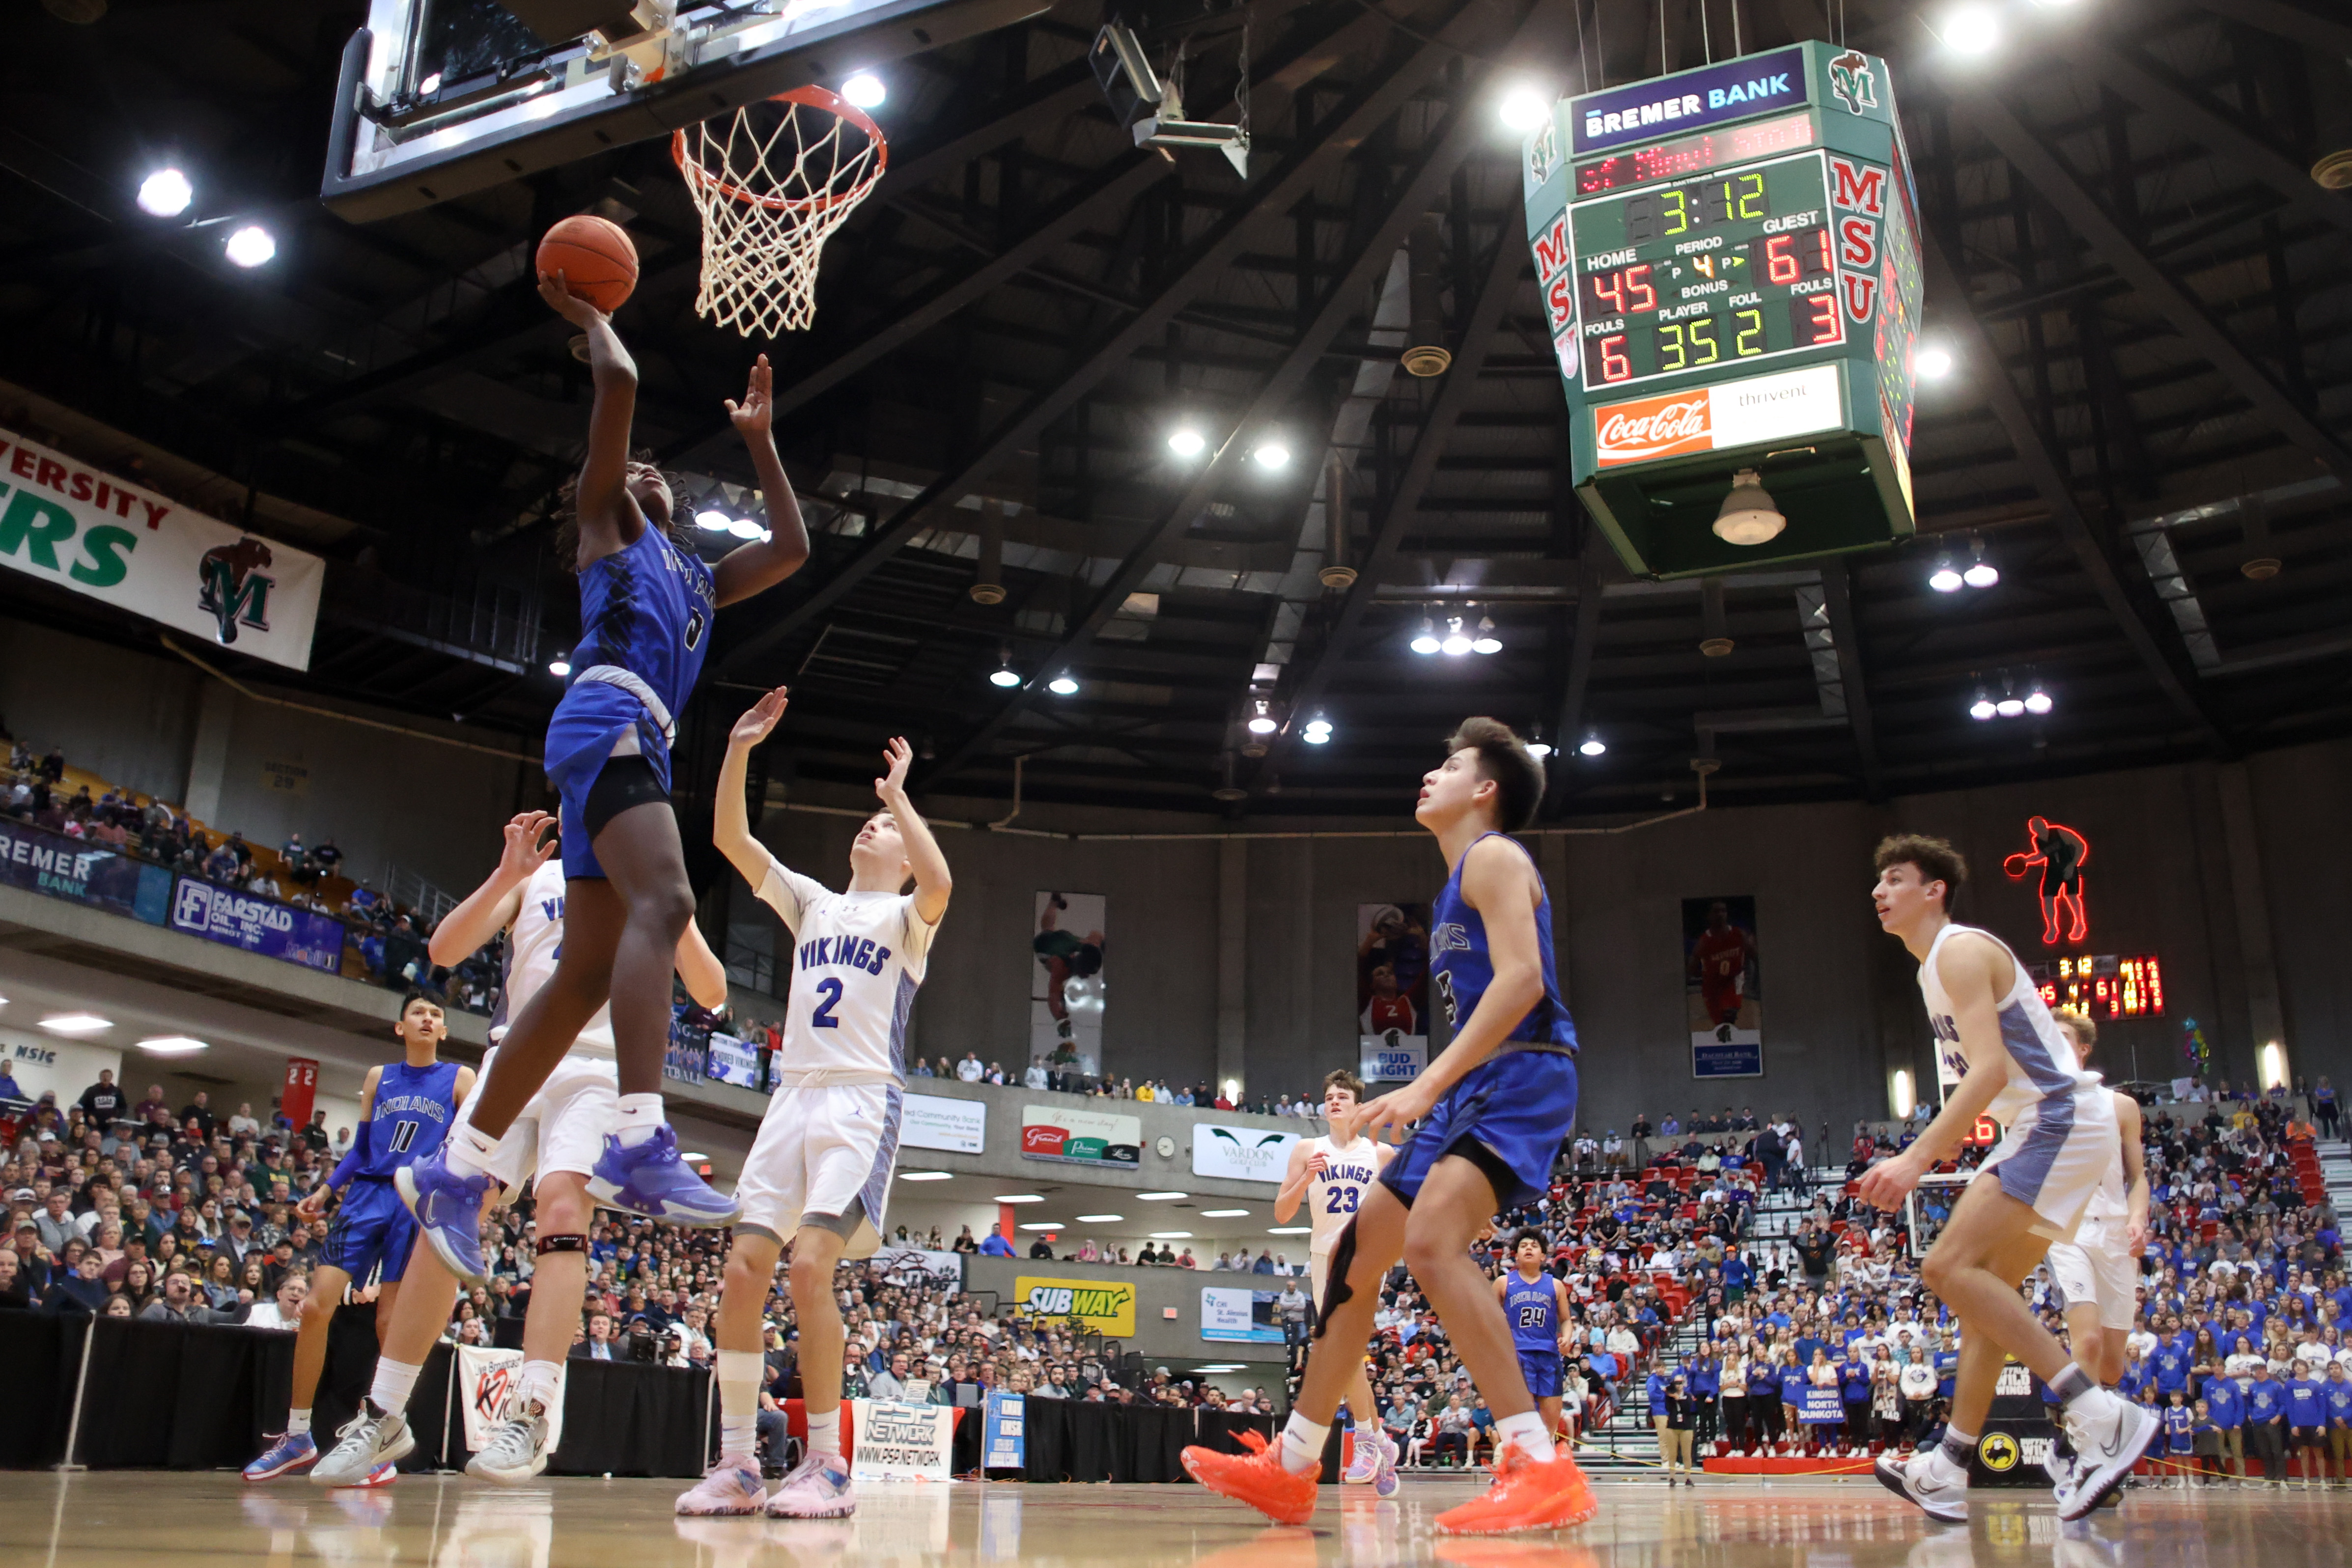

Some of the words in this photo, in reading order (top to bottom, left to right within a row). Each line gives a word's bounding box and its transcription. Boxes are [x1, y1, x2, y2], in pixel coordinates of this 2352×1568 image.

[1586, 93, 1700, 138] BREMER
[1708, 72, 1791, 110] BANK
[1660, 172, 1764, 236] 3:12
[1763, 210, 1820, 234] GUEST
[1675, 236, 1723, 255] PERIOD
[1766, 228, 1833, 285] 61
[1587, 249, 1637, 271] HOME
[1693, 254, 1714, 279] 4
[1594, 264, 1657, 314] 45
[1681, 280, 1729, 299] BONUS
[1791, 277, 1833, 295] FOULS
[1658, 301, 1708, 321] PLAYER
[1729, 292, 1763, 308] FOUL
[1585, 318, 1625, 336] FOULS
[1808, 293, 1841, 343] 3
[1736, 308, 1763, 356] 2
[1658, 318, 1718, 371] 35
[1600, 335, 1631, 383] 6
[1738, 383, 1807, 407] thrivent
[1598, 398, 1708, 449] Coca-Cola
[0, 480, 138, 587] RS
[38, 871, 87, 898] BANK
[212, 891, 294, 932] FARSTAD
[800, 934, 892, 977] VIKINGS
[2059, 957, 2092, 977] 3:12
[812, 977, 843, 1028] 2
[1372, 1064, 1417, 1076] LIGHT
[1378, 1052, 1411, 1064] BUD
[373, 1095, 445, 1123] INDIANS
[917, 1110, 960, 1122] Community
[962, 1115, 980, 1124] Bank
[388, 1120, 419, 1153] 11
[1222, 1146, 1274, 1160] VARDON
[1317, 1164, 1373, 1184] VIKINGS
[1326, 1186, 1359, 1214] 23
[1020, 1286, 1131, 1317] SUBWAY
[1509, 1290, 1551, 1309] INDIANS
[1519, 1307, 1547, 1328] 24
[1806, 1390, 1838, 1399] KINDRED
[1995, 1385, 2032, 1396] WINGS
[1807, 1400, 1839, 1409] NORTH
[865, 1420, 935, 1445] NETWORK
[857, 1446, 941, 1466] WWW.PSP.NETWORK
[2022, 1456, 2044, 1465] WIN
